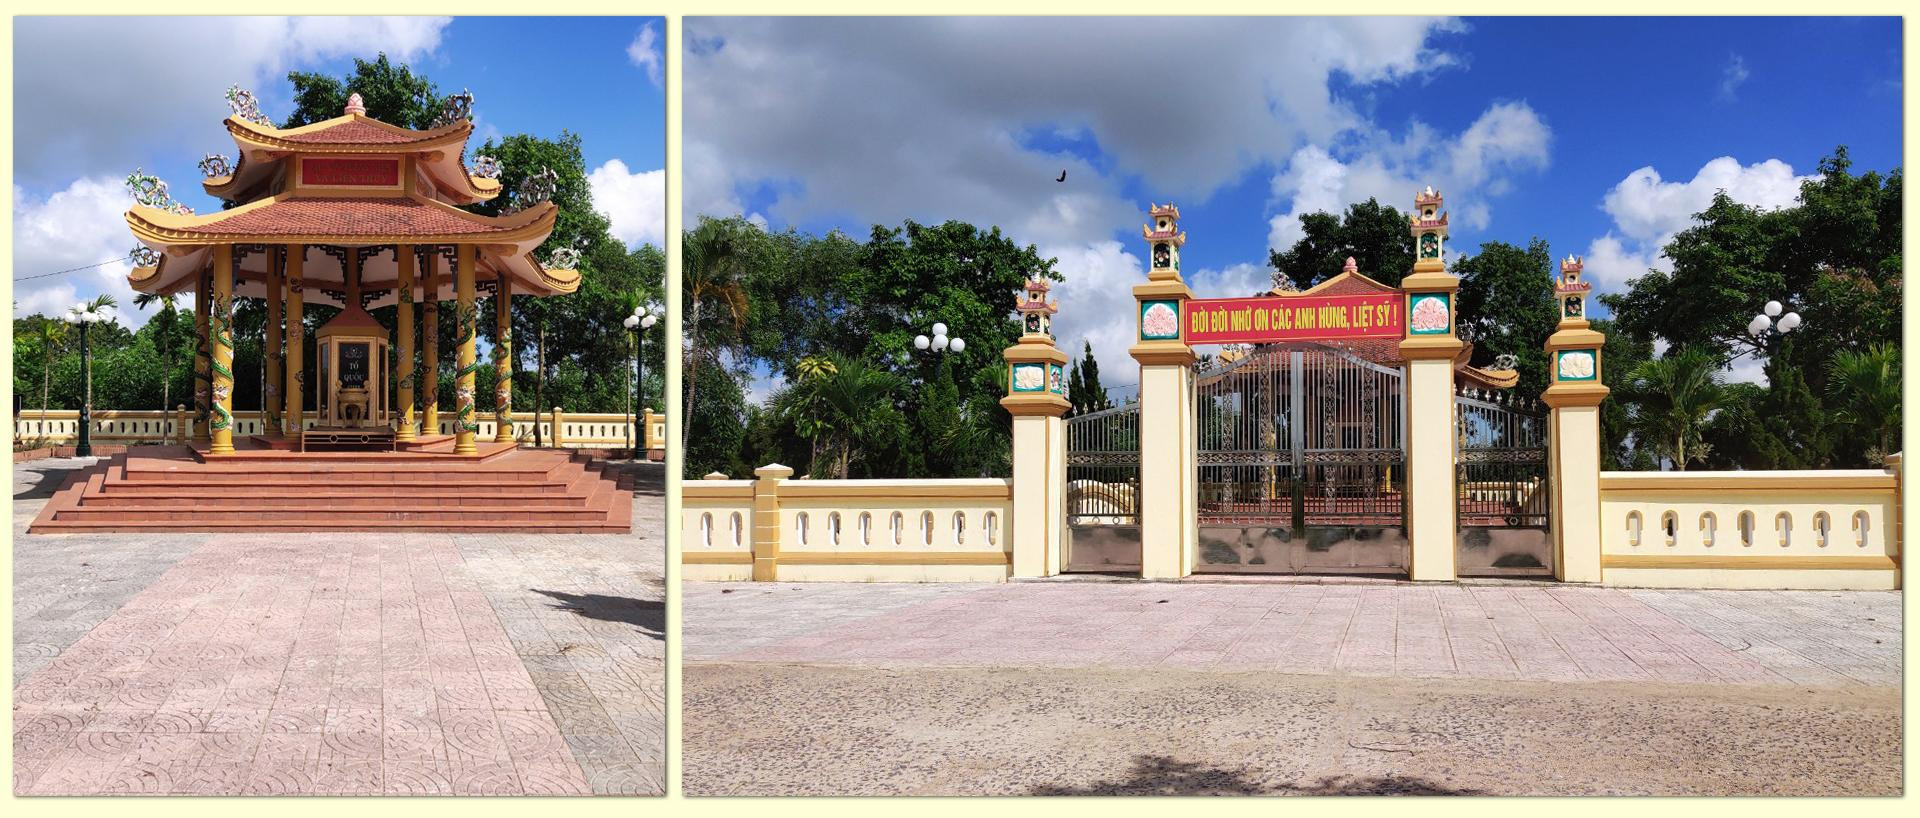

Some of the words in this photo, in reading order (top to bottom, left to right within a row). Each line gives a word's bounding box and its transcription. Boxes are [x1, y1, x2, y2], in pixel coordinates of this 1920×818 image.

[1191, 305, 1209, 333] ĐỜI
[1211, 304, 1229, 333] ĐỜI
[1230, 304, 1252, 332] NHỚ
[1254, 307, 1269, 331] ƠN
[1271, 303, 1292, 330] CÁC
[1294, 307, 1316, 330] ANH
[1318, 302, 1350, 331] HÙNG,
[1353, 301, 1374, 332] LIỆT
[1376, 300, 1391, 327] SỸ
